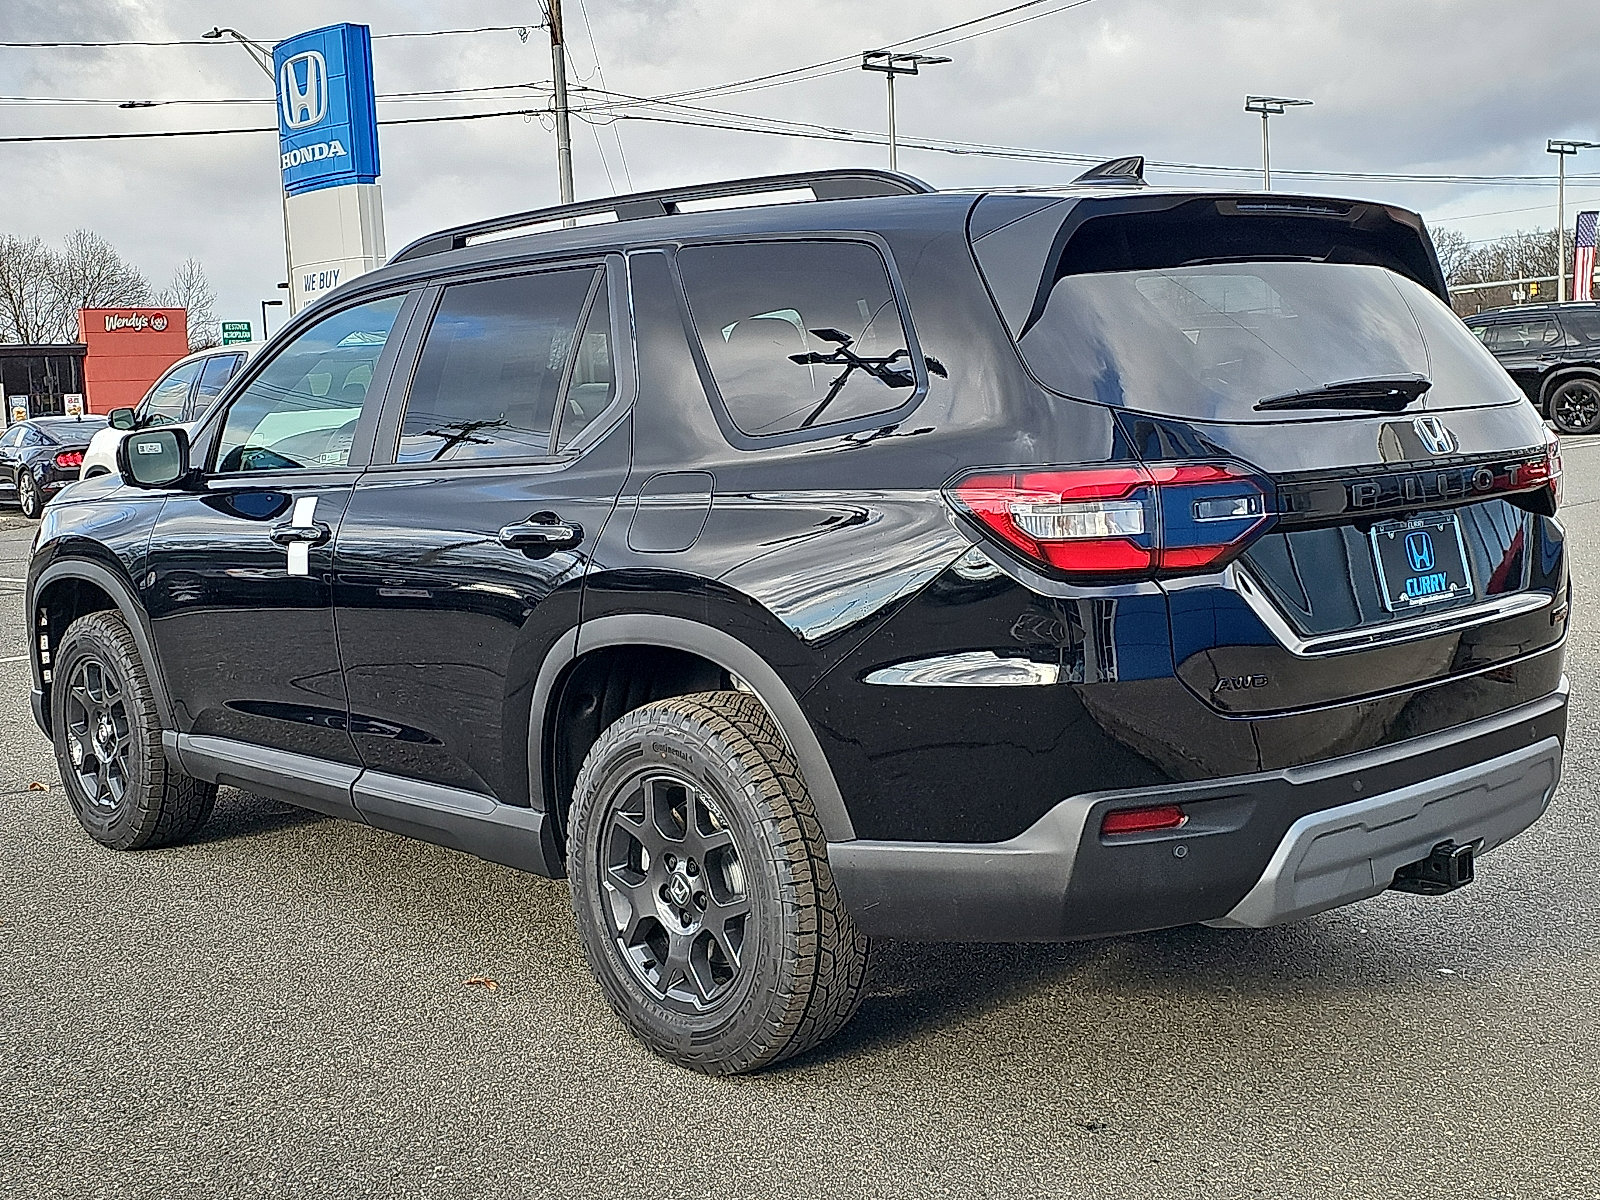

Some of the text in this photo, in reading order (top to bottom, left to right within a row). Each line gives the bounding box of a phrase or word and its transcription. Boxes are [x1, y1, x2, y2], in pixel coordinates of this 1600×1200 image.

[281, 140, 347, 170] HONDA
[304, 269, 340, 292] WE BUY
[104, 312, 148, 332] Wendy's
[1352, 464, 1523, 508] PILOT
[1406, 572, 1448, 597] CURRY
[1213, 673, 1269, 693] AWD
[652, 741, 689, 762] Continental
